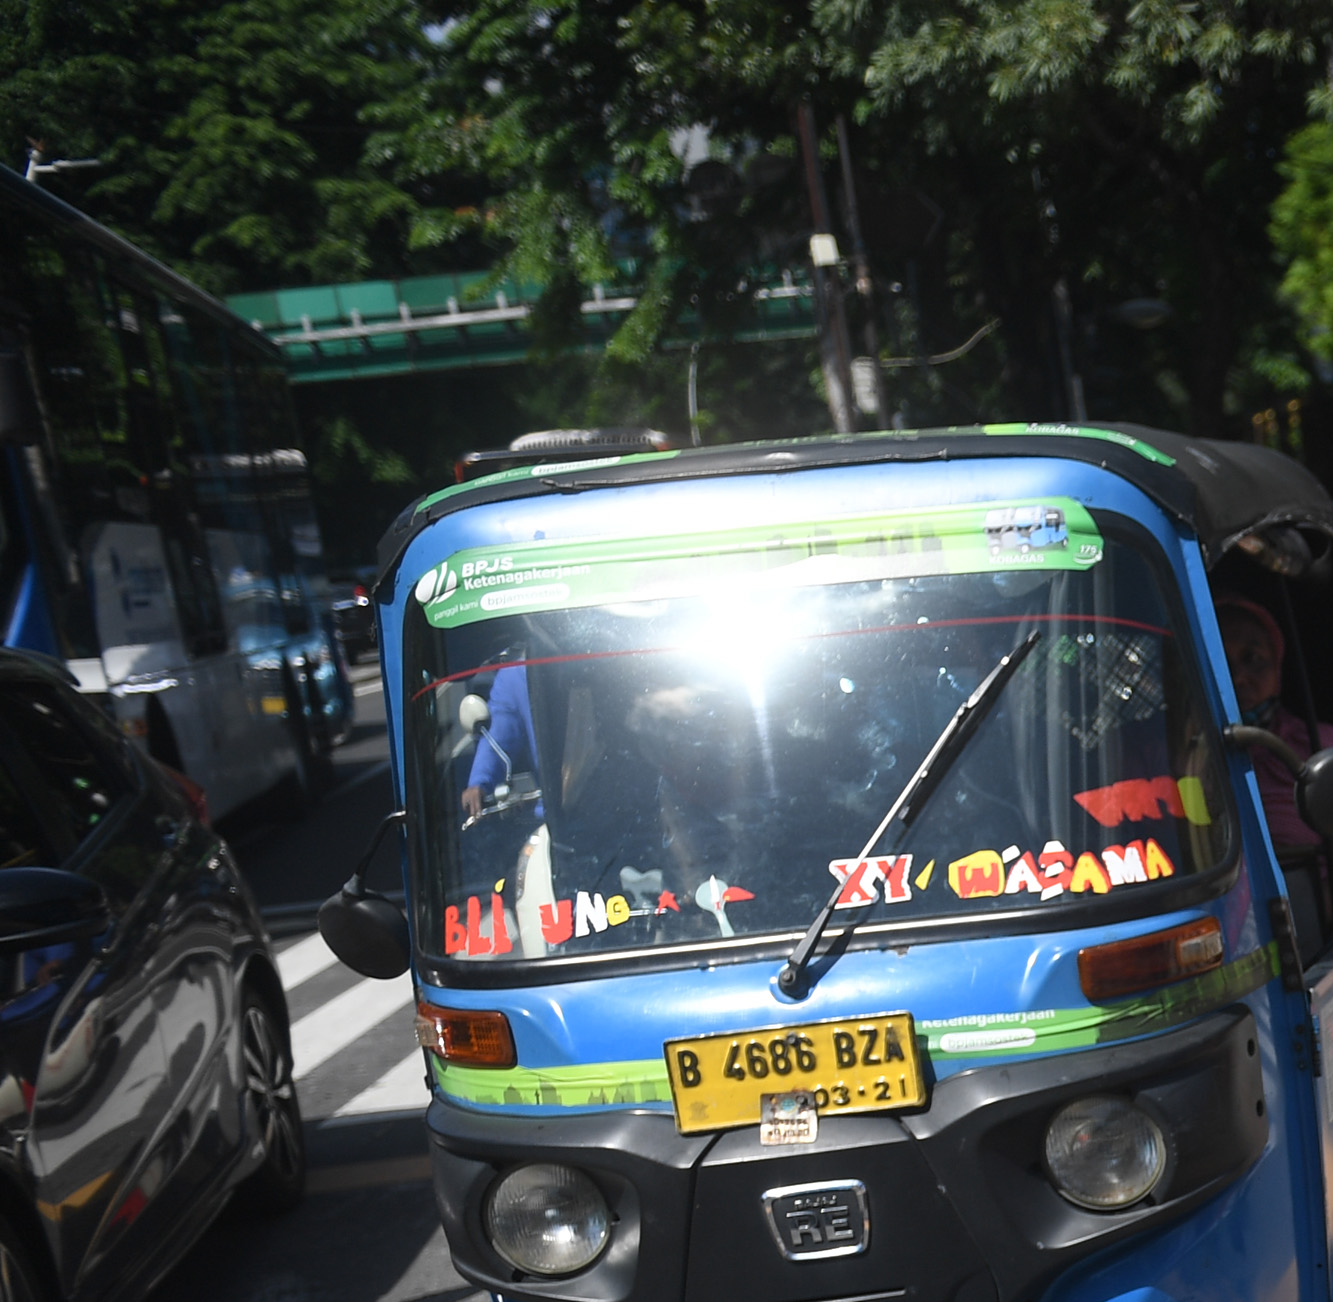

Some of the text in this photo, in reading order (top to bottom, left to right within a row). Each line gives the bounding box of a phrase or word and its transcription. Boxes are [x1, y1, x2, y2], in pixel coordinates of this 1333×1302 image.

[462, 557, 514, 578] BPJS
[463, 565, 590, 590] Ketenagakerjaan
[434, 605, 459, 622] panggil
[459, 601, 478, 612] kami
[677, 1023, 904, 1087] B 4686 BZA
[786, 1205, 853, 1245] RE
